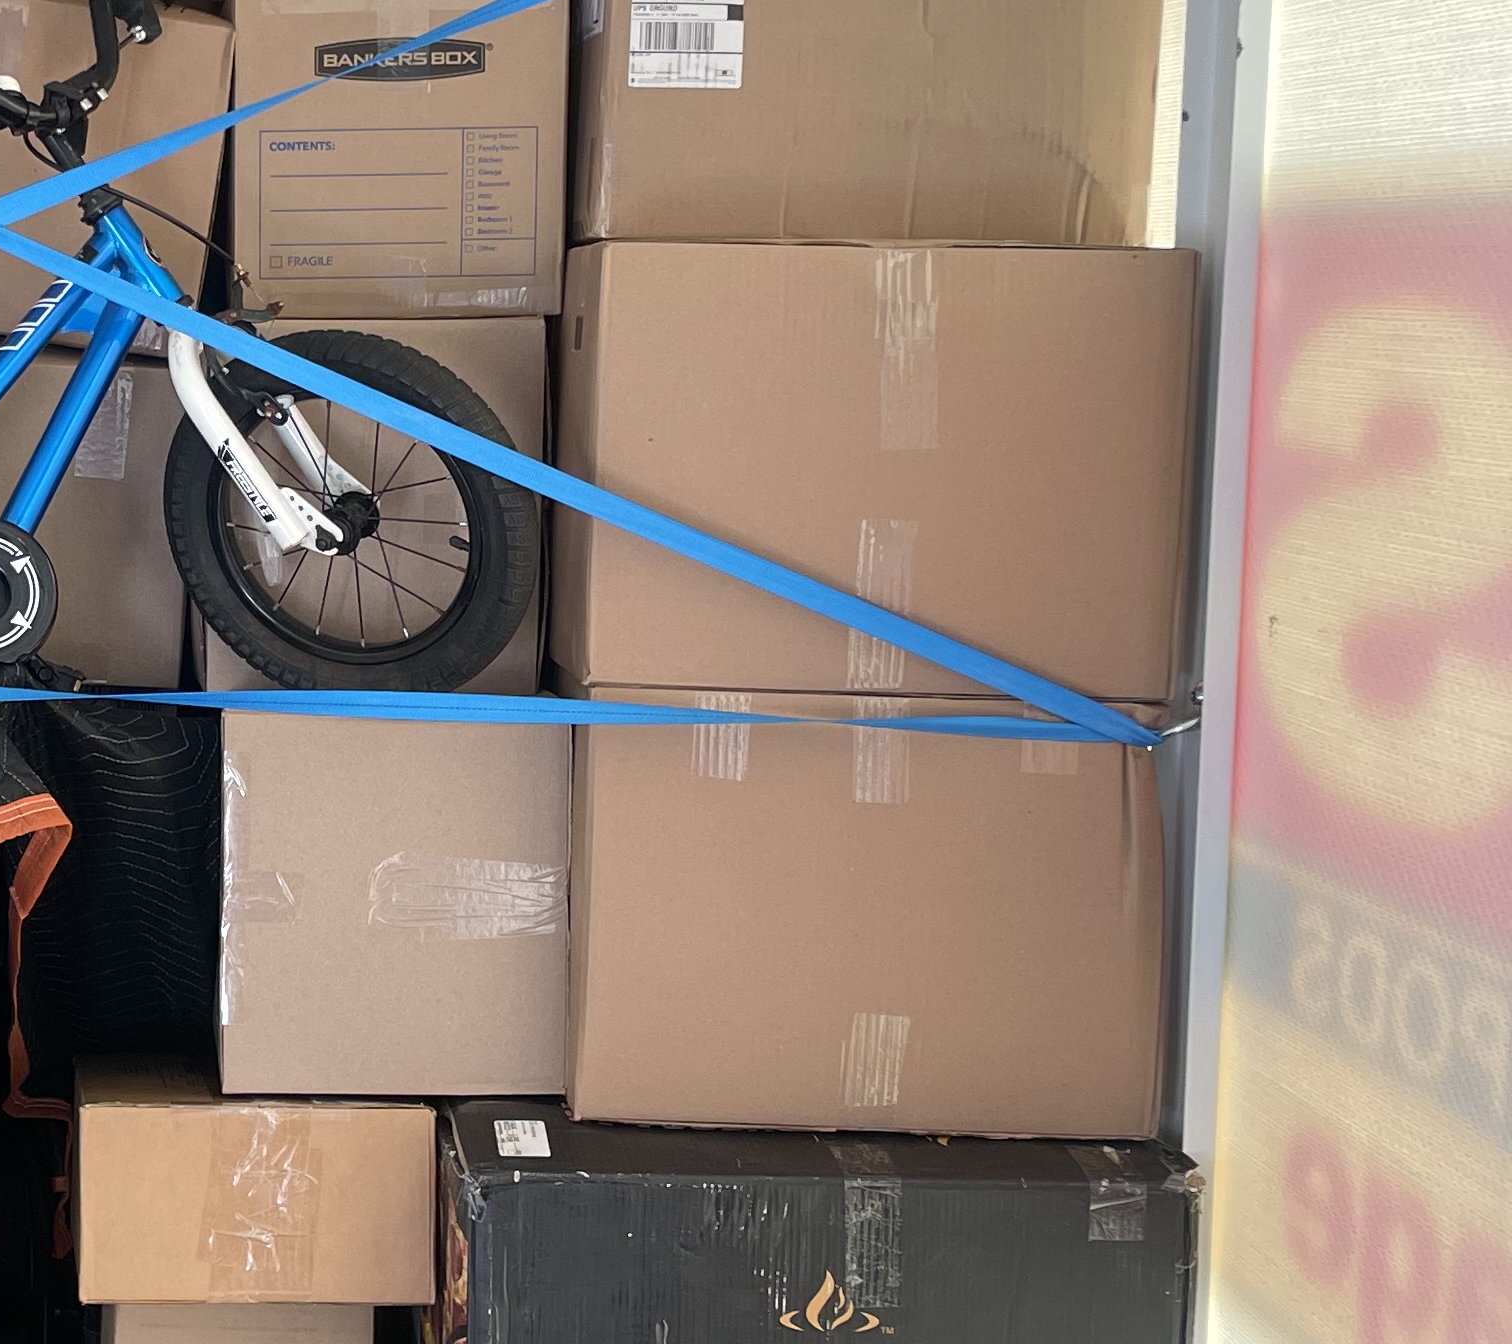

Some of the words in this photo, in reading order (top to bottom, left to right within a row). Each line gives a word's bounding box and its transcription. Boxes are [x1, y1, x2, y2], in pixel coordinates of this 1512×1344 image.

[431, 51, 478, 64] BOX
[478, 133, 497, 141] Living
[269, 140, 336, 153] CONTENTS:
[288, 256, 334, 267] FRAGILE
